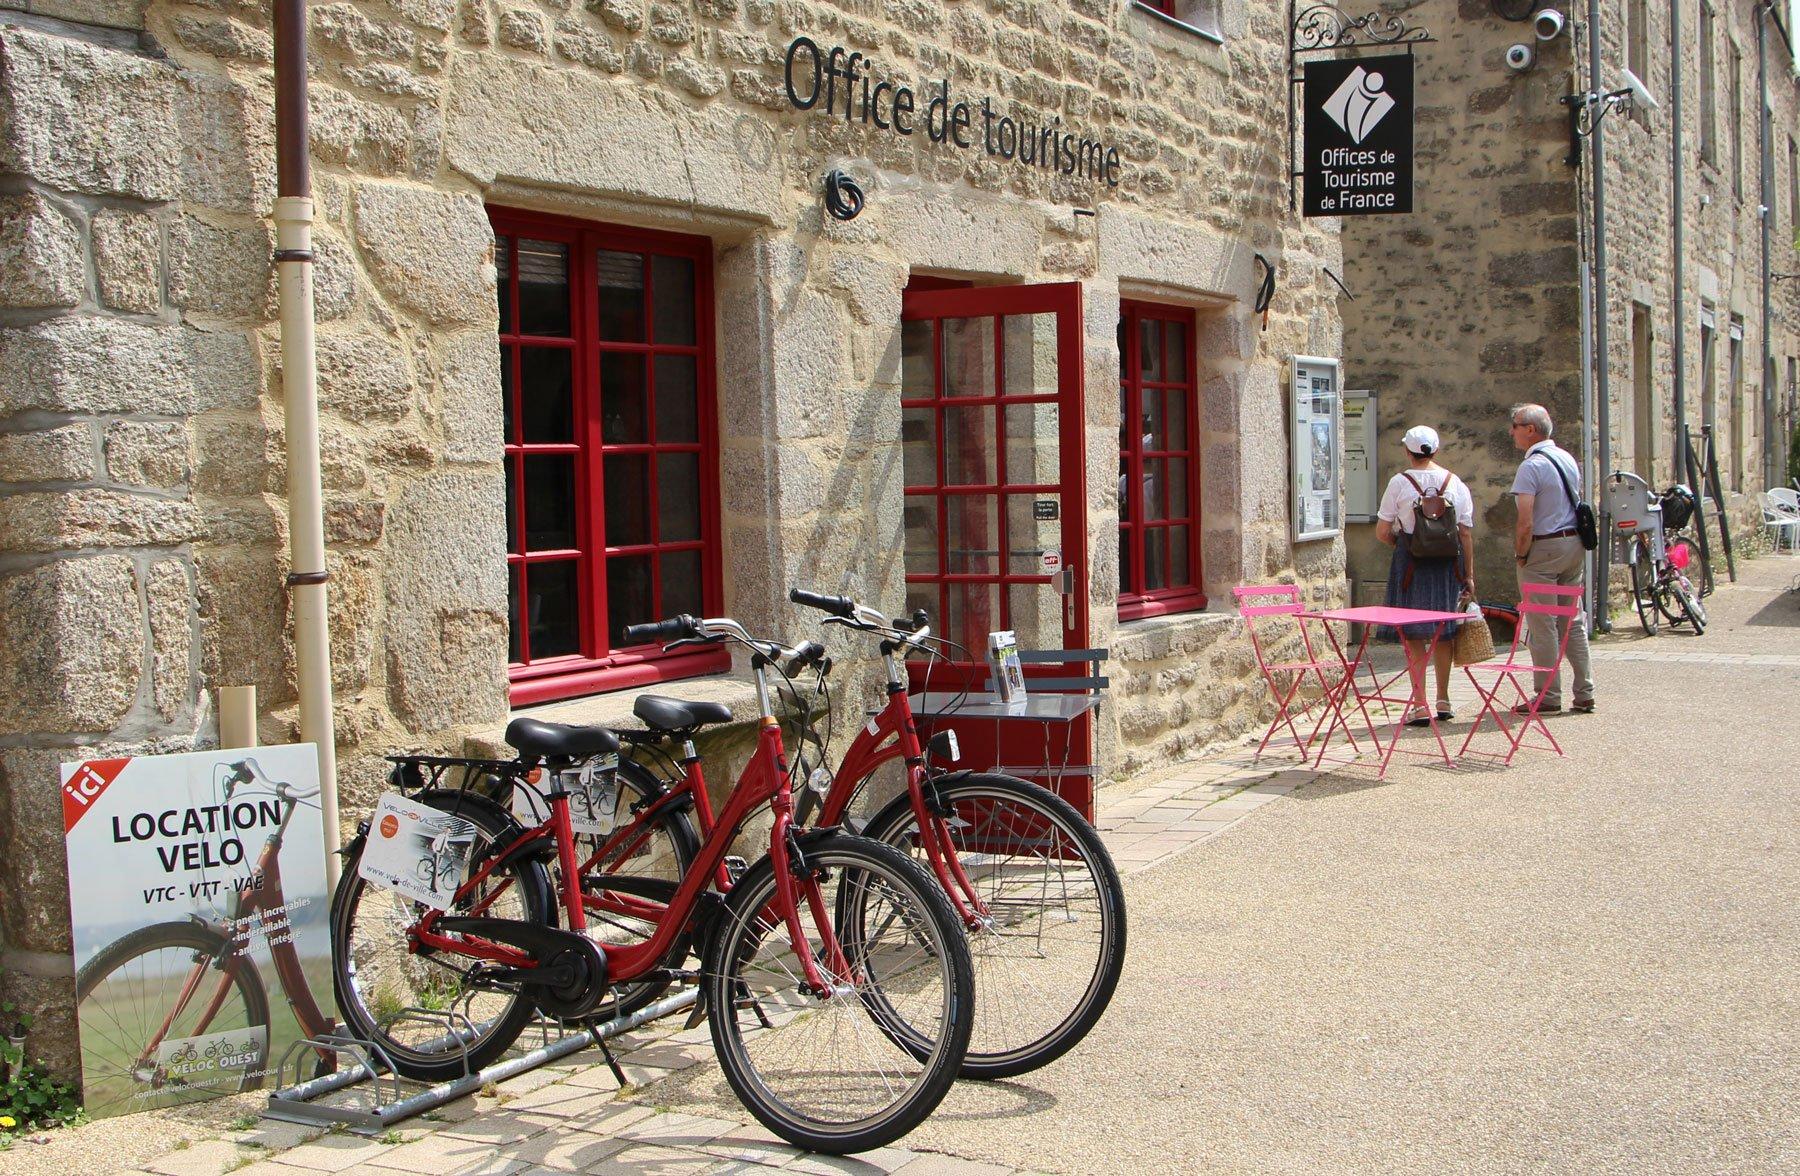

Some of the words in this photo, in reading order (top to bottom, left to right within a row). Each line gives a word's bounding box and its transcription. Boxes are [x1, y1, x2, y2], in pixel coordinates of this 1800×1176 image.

[785, 37, 914, 136] Office
[927, 79, 970, 149] de
[981, 96, 1121, 187] tourisme
[1321, 148, 1376, 167] Offices
[1380, 149, 1395, 164] de
[1321, 169, 1395, 188] Tourisme
[1320, 196, 1336, 210] de
[1340, 191, 1395, 208] France
[66, 765, 106, 806] ici
[112, 800, 282, 843] LOCATION
[156, 838, 244, 873] VELO
[143, 886, 176, 904] VTC
[189, 880, 221, 898] VTT
[233, 875, 264, 893] VAE
[236, 911, 262, 929] pneus
[263, 897, 311, 918] increvables
[171, 1059, 215, 1077] VELOC
[219, 1051, 259, 1068] OUEST
